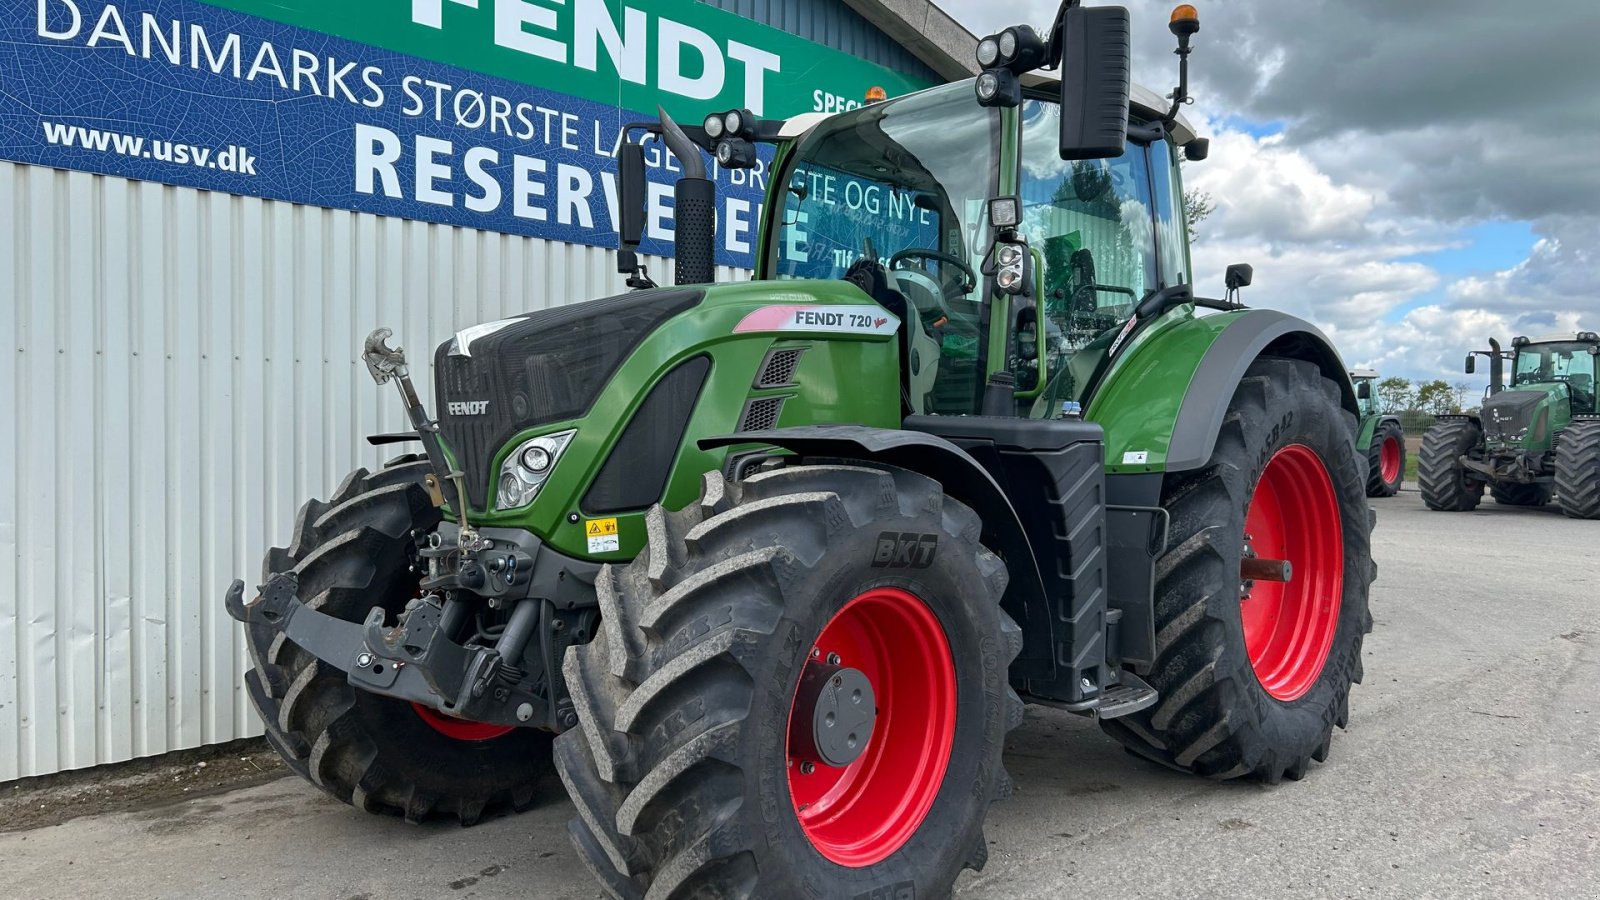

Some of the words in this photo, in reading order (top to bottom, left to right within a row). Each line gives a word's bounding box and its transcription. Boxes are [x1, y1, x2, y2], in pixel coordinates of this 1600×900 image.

[37, 0, 386, 108] DANMARKS
[402, 75, 579, 151] STØRSTE
[845, 180, 880, 215] OG
[43, 121, 257, 176] www.usv.dk
[795, 310, 844, 326] FENDT
[849, 314, 872, 328] 720
[448, 400, 490, 416] FENDT
[873, 535, 937, 566] BKT
